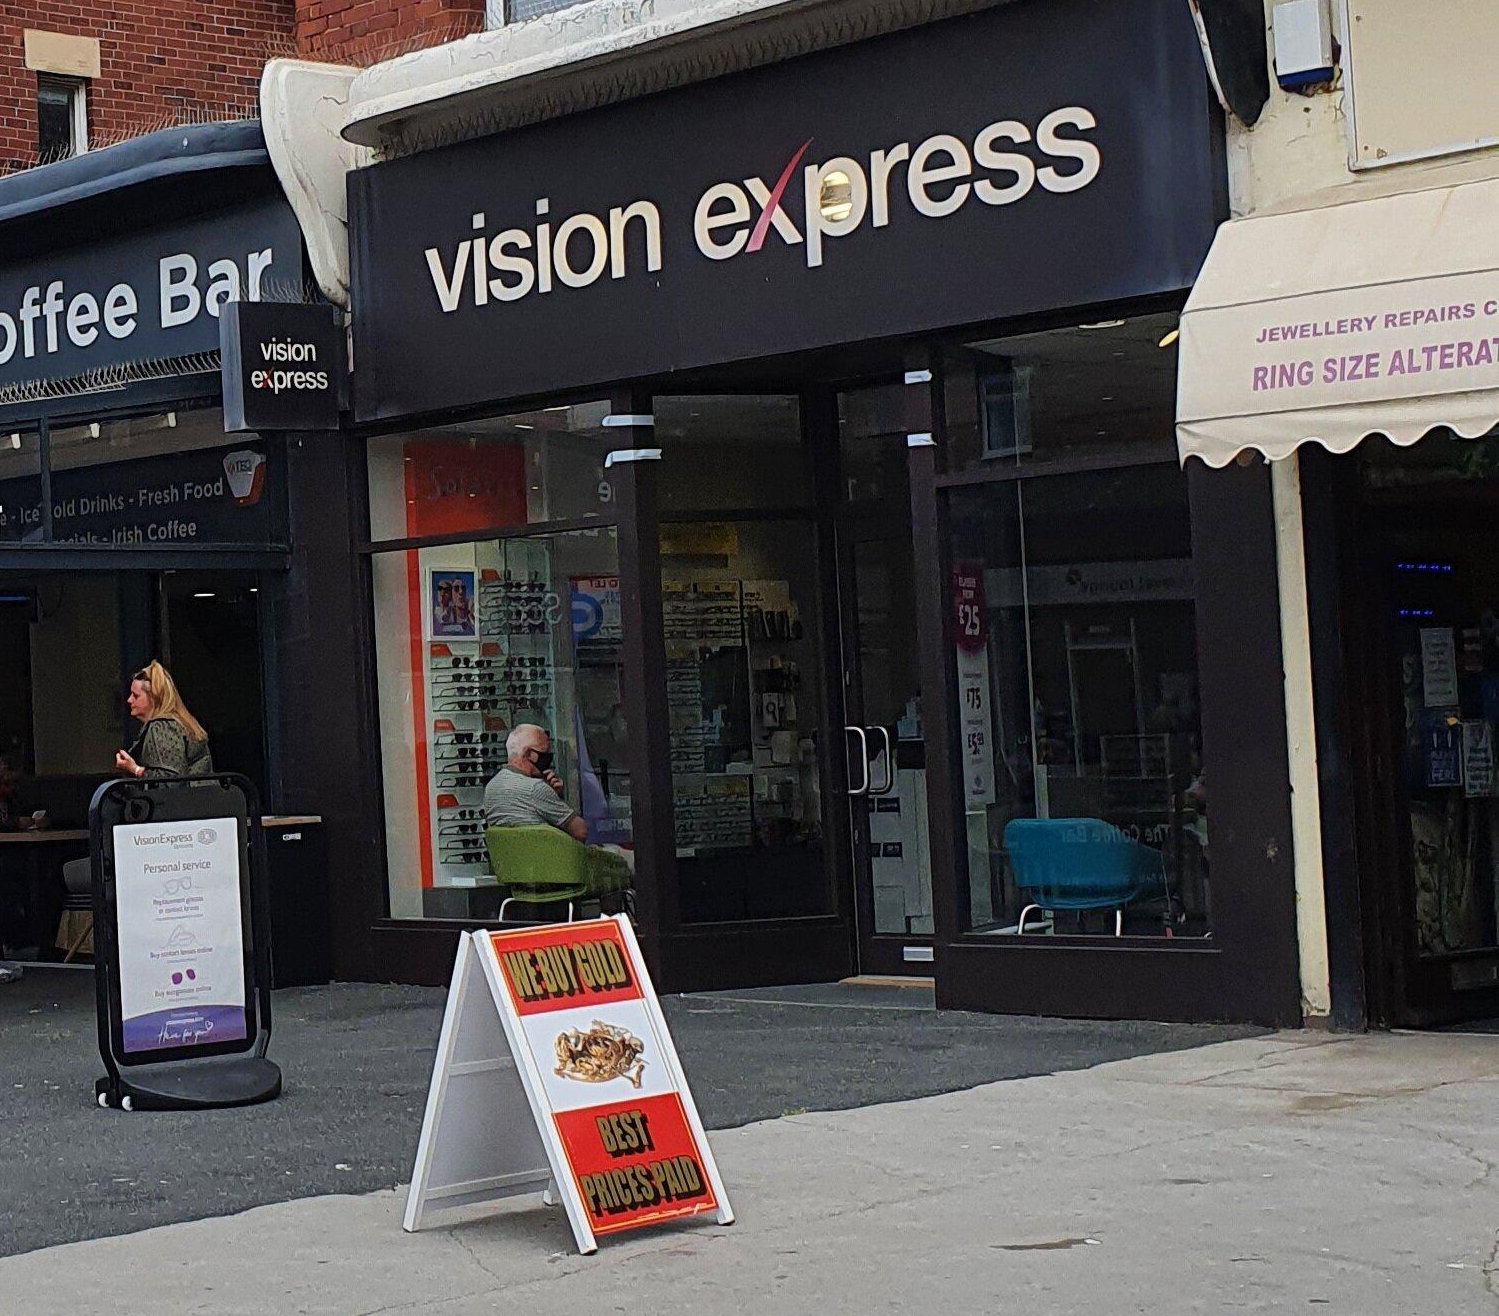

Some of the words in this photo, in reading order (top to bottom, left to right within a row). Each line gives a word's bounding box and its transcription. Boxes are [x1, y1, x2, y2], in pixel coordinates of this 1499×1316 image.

[424, 197, 663, 313] vision
[692, 106, 1102, 268] express
[159, 247, 274, 329] Bar
[1256, 314, 1378, 344] JEWELLERY
[1383, 303, 1477, 329] REPAIRS
[260, 336, 317, 362] vision
[251, 367, 329, 395] express
[1252, 360, 1315, 391] RING
[1322, 352, 1380, 384] SIZE
[53, 501, 76, 520] old
[80, 495, 125, 517] Drinks
[138, 484, 180, 508] Fresh
[183, 477, 225, 500] Food
[112, 525, 144, 544] Irish
[148, 519, 198, 541] Coffee
[959, 604, 981, 635] £25
[143, 860, 181, 875] Personal
[182, 860, 211, 872] service
[503, 947, 543, 1000] WE
[539, 944, 578, 995] BUY
[576, 937, 629, 990] GOLD
[595, 1109, 651, 1154] BEST
[579, 1160, 654, 1213] PRICES
[648, 1154, 704, 1202] PAID
